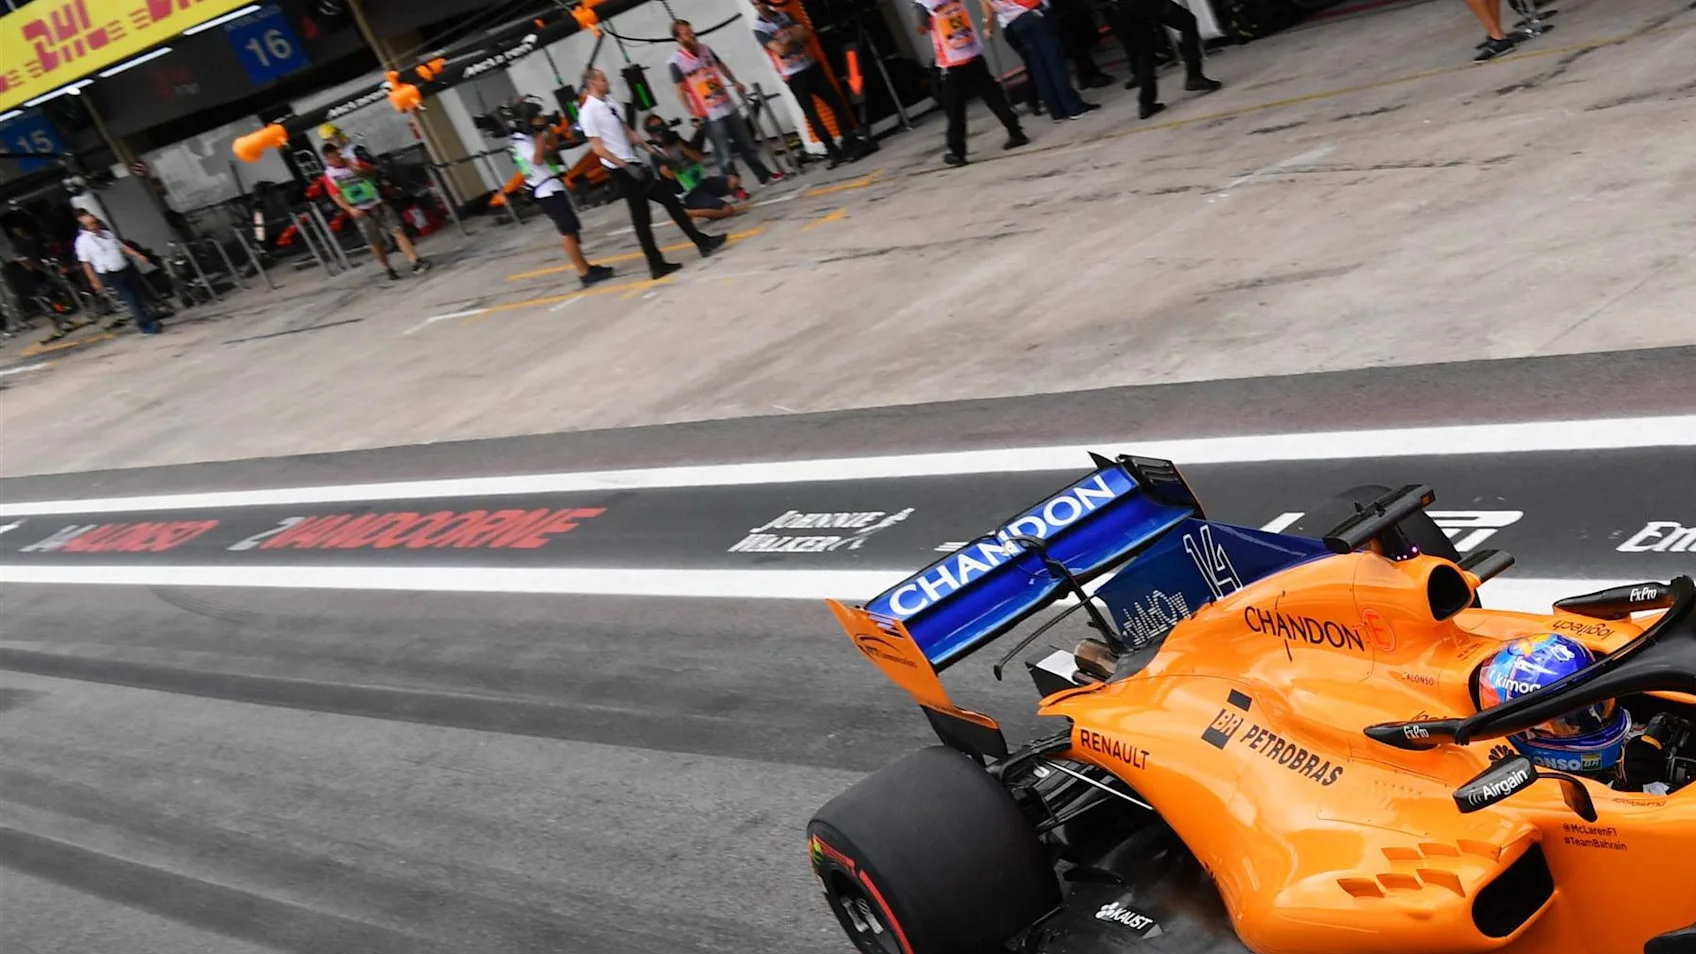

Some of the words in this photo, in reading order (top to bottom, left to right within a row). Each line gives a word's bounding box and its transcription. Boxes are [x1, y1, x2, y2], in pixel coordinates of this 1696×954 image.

[245, 28, 293, 67] 16
[16, 129, 55, 154] 15
[257, 507, 608, 550] VANDOORNE
[888, 474, 1118, 617] CHANDON
[1182, 523, 1244, 602] 14
[1629, 587, 1658, 602] FxPro
[1244, 605, 1365, 652] CHANDON
[1551, 619, 1616, 640] logitech
[1080, 728, 1150, 770] RENAULT
[1239, 724, 1344, 786] PETROBRAS
[1482, 769, 1529, 801] Airgain
[1562, 822, 1618, 837] @McLarenF1
[1563, 836, 1628, 851] #TeamBahrain
[1108, 908, 1154, 930] KAUST
